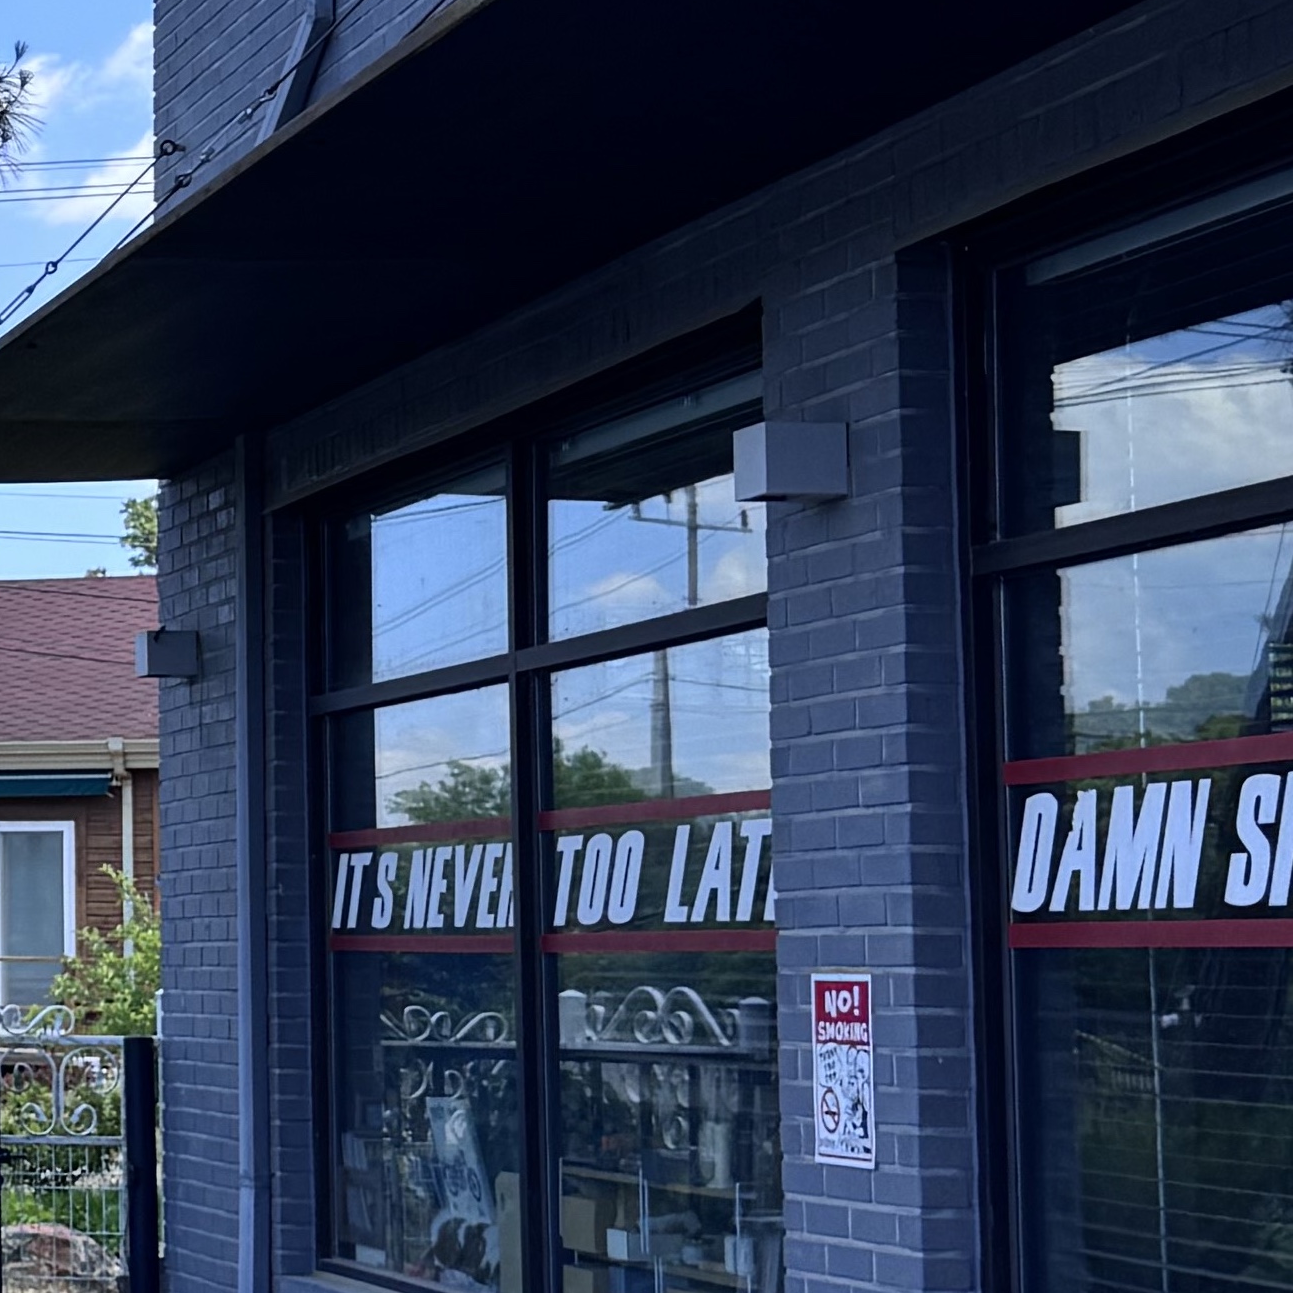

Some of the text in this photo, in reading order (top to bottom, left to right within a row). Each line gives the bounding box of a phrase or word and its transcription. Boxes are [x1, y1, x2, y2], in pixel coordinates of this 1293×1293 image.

[553, 830, 645, 926] TOO
[664, 819, 777, 923] LAT
[1011, 778, 1211, 913] DAMN
[817, 1021, 868, 1043] SMOKING
[824, 986, 860, 1017] NO!
